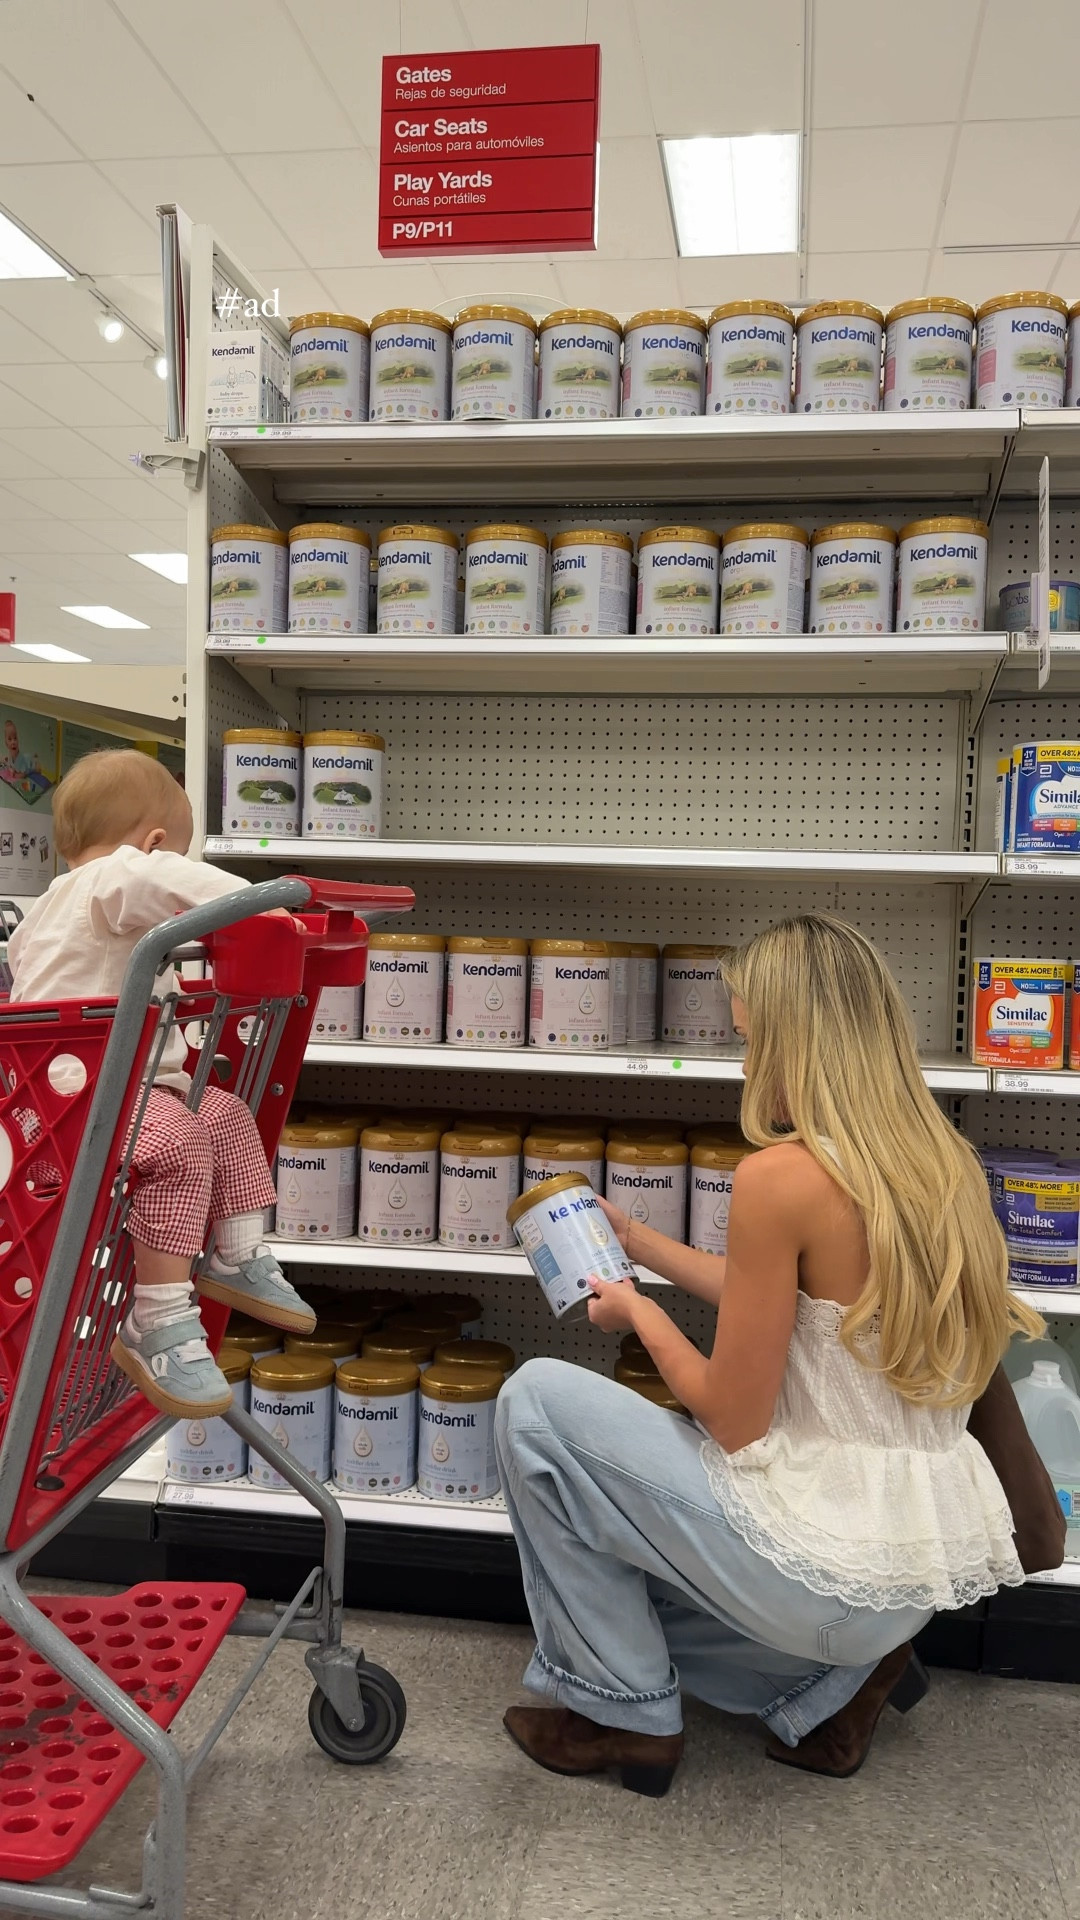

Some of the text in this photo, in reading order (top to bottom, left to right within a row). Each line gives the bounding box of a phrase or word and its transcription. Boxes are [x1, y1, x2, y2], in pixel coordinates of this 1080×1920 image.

[396, 66, 452, 84] Gates
[396, 84, 506, 101] Rejas de seguridad
[394, 118, 487, 138] Car Seats
[394, 136, 544, 153] Asientos para automóviles
[394, 171, 492, 193] Play Yards
[393, 193, 486, 207] Cunas portátiles
[392, 221, 452, 239] P9/P11
[455, 331, 513, 351] Kendamil
[722, 327, 786, 345] Kendamil
[812, 327, 875, 345] Kendamil
[908, 324, 971, 345] Kendamil
[212, 346, 255, 356] Kendamil
[292, 339, 348, 357] Kendamil
[375, 335, 436, 352] Kendamil
[552, 336, 614, 355] Kendamil
[642, 336, 702, 357] Kendamil
[212, 551, 260, 566] endamil
[291, 549, 348, 565] Kendamil
[469, 551, 528, 568] Kendamil
[817, 550, 881, 568] Kendamil
[910, 544, 978, 561] Kendamil
[652, 553, 714, 570] Kendamil
[236, 755, 297, 770] Kendamil
[312, 756, 373, 771] Kendamil
[370, 960, 428, 973] Kendamil
[463, 964, 522, 977] Kendamil
[997, 1006, 1047, 1021] Similac
[279, 1158, 326, 1170] endamil
[369, 1161, 429, 1174] Kendamil
[442, 1164, 497, 1179] Kendamil
[612, 1173, 673, 1189] Kendamil
[696, 1177, 732, 1193] Kenda
[1008, 1211, 1055, 1228] Similac
[1028, 1274, 1051, 1282] FORMULA
[254, 1398, 314, 1416] Kendamil
[338, 1402, 398, 1421] Kendamil
